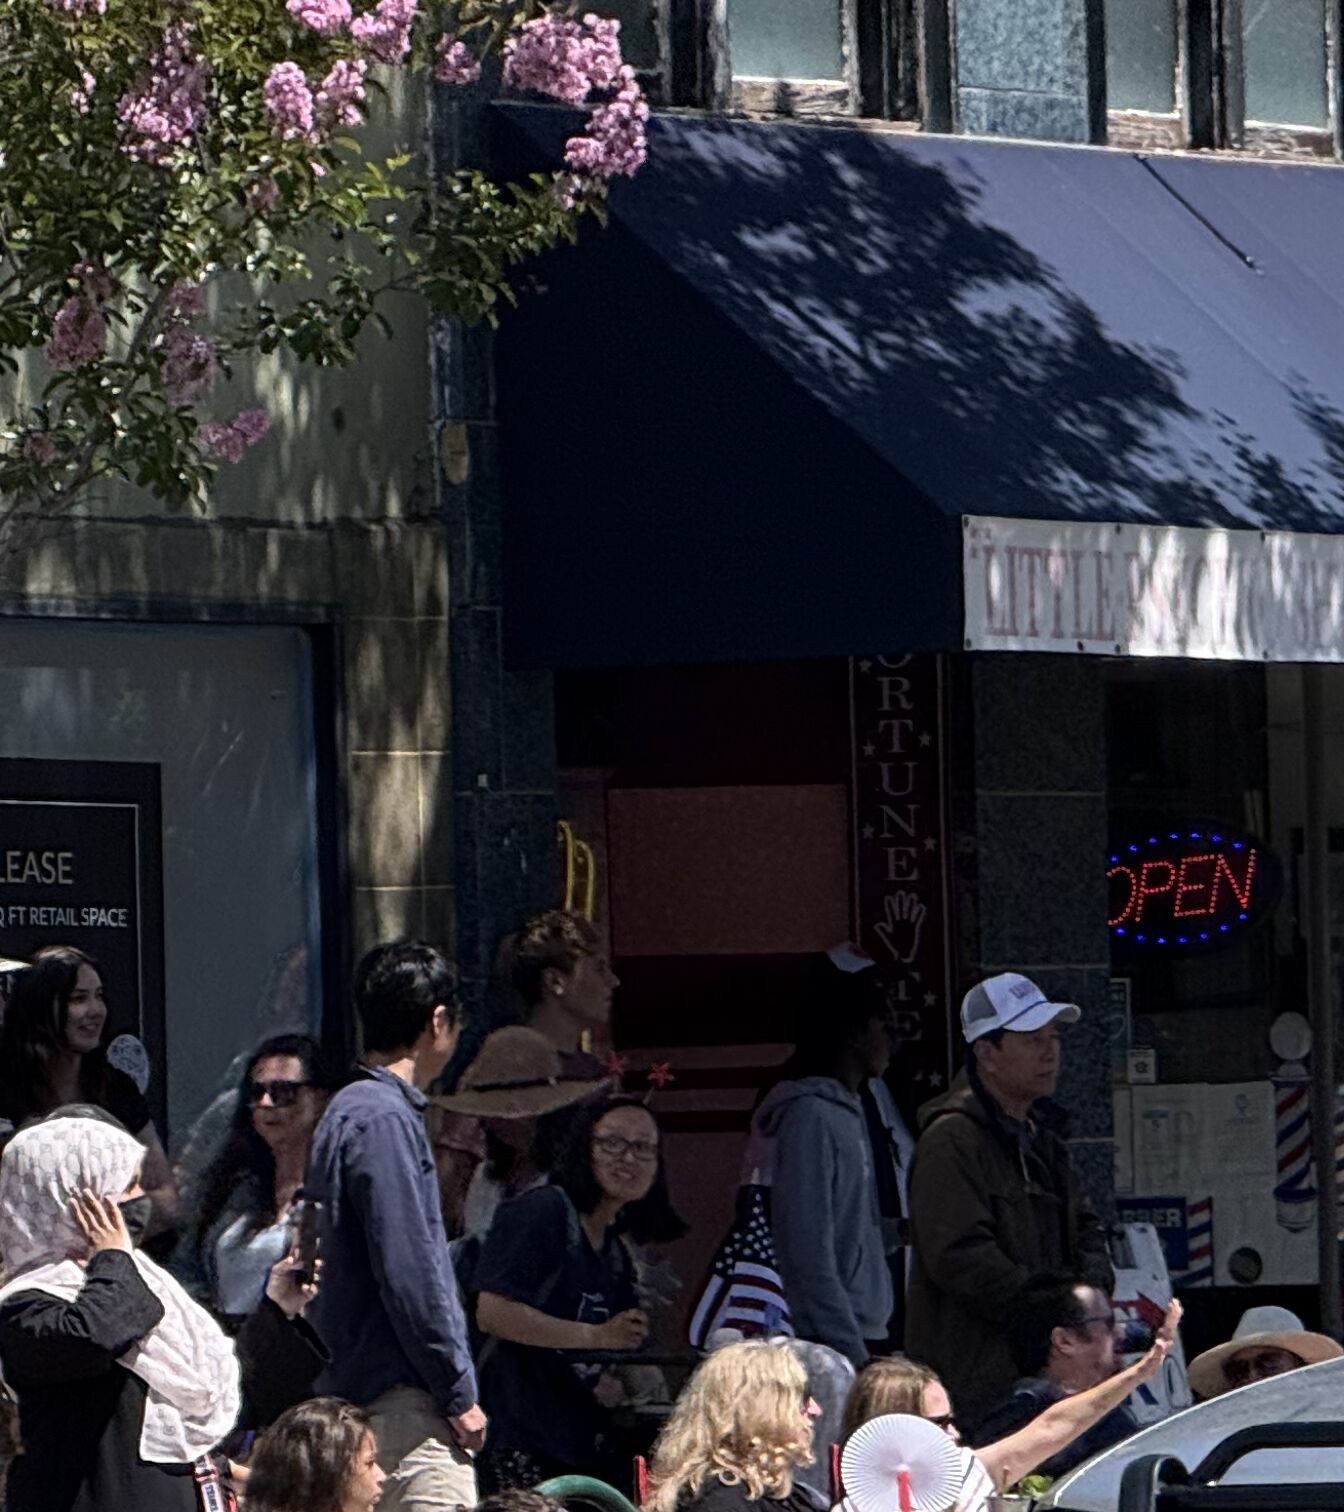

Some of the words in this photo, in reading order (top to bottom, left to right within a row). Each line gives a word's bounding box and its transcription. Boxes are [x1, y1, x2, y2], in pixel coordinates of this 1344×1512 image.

[0, 851, 73, 885] EASE
[1105, 848, 1256, 926] OPEN
[8, 906, 26, 926] FT
[29, 907, 79, 926] RETAIL
[81, 908, 128, 927] SPACE
